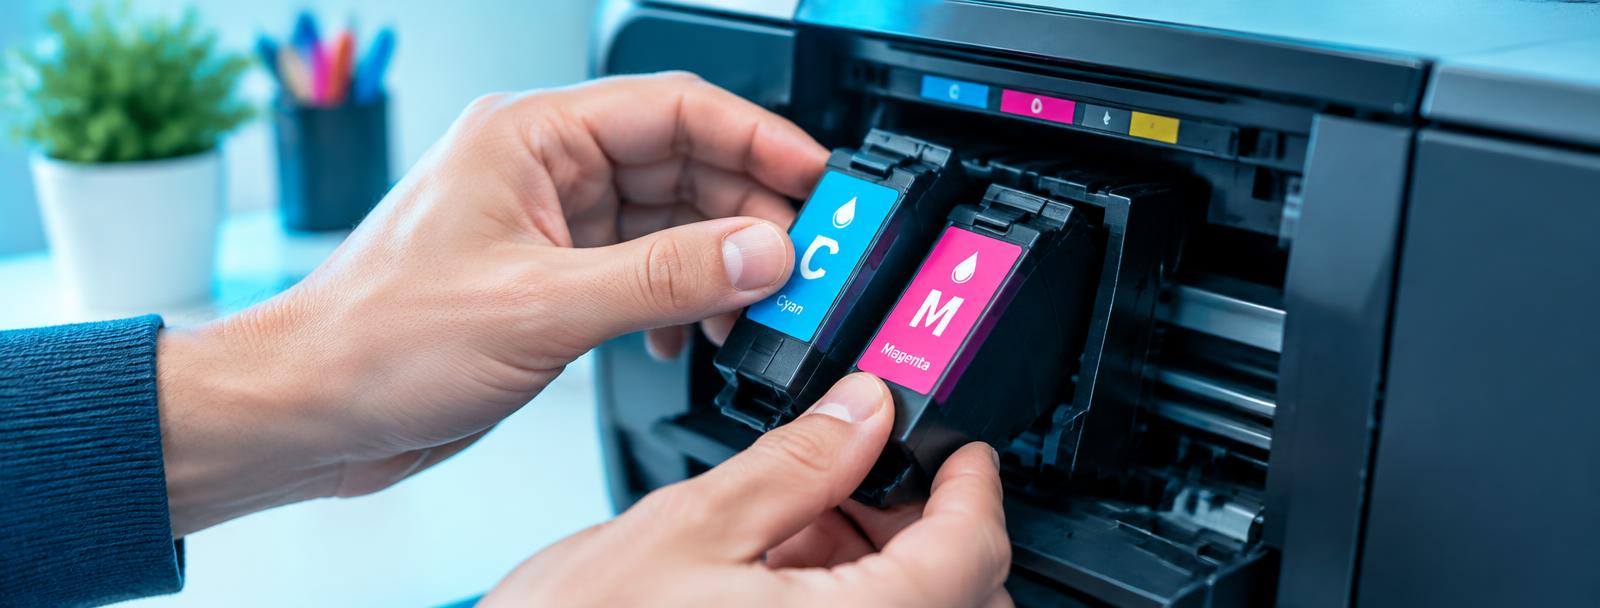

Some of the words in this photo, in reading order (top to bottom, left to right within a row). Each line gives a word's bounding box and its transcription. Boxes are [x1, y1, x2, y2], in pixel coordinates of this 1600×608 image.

[800, 234, 839, 280] C
[776, 294, 804, 315] Cyan
[908, 288, 965, 337] M
[881, 342, 931, 371] Magenta
